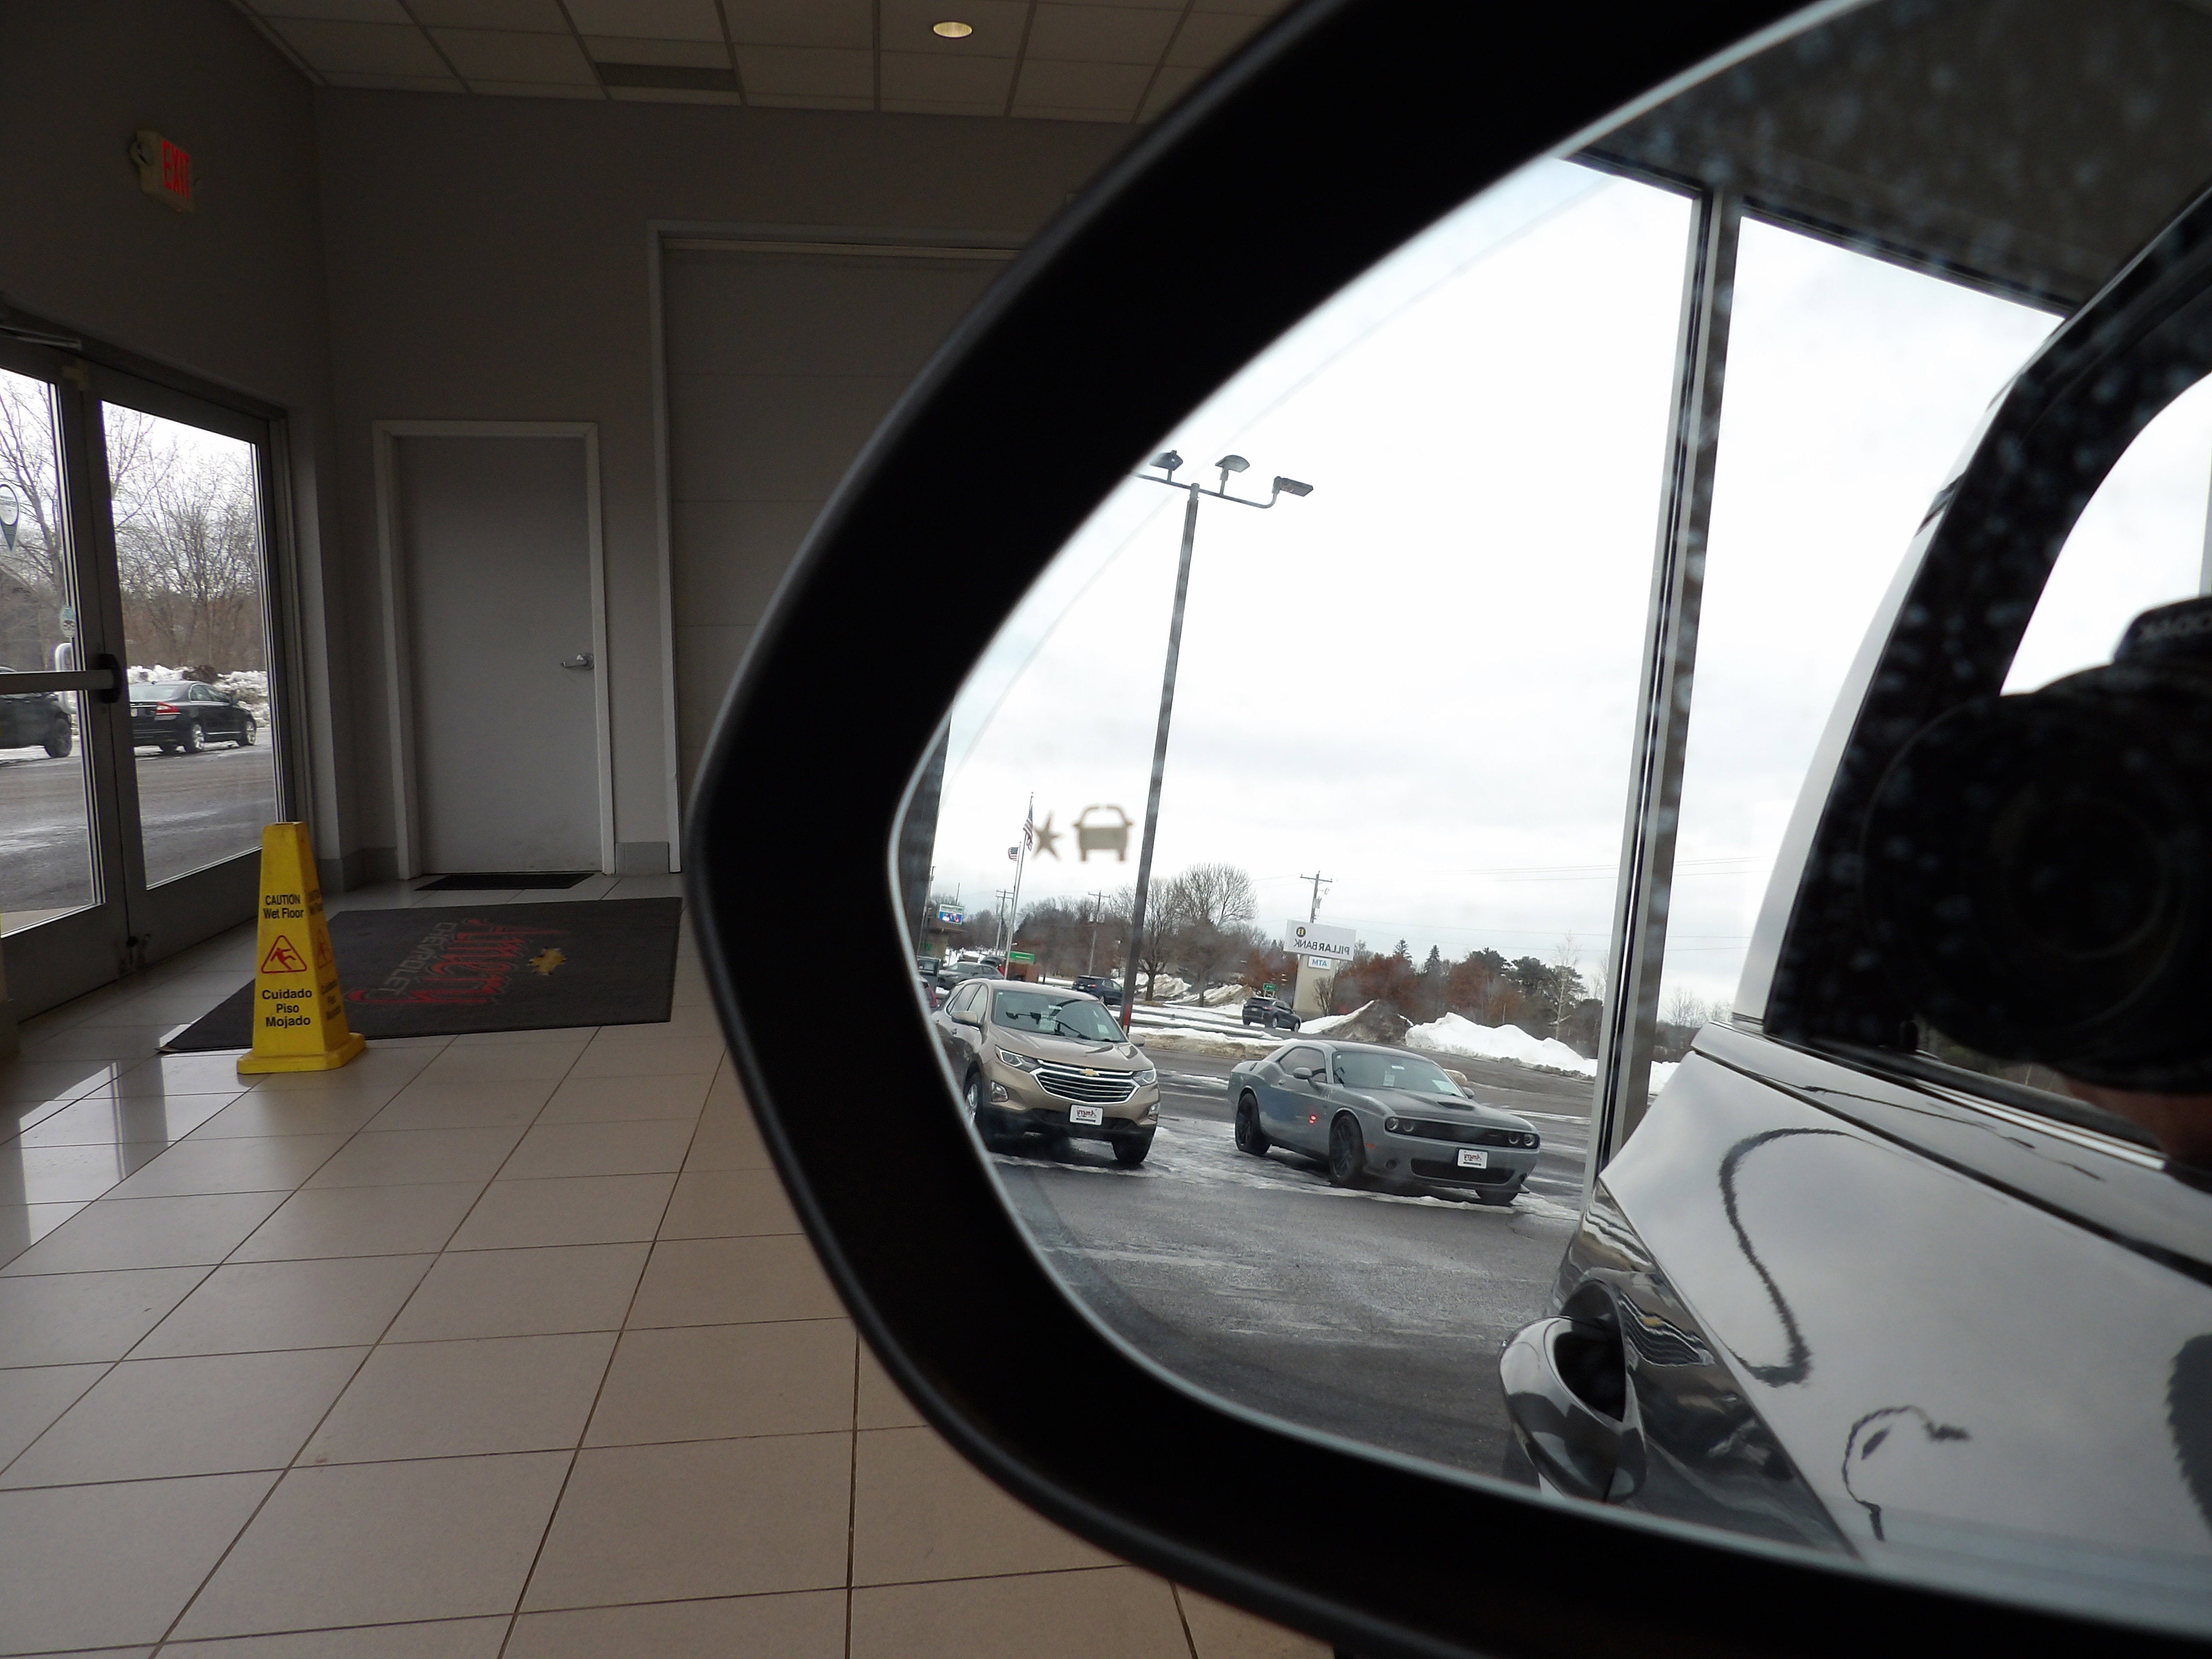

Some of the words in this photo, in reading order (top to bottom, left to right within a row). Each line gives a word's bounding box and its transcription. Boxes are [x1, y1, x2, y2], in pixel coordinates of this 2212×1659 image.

[162, 140, 189, 200] EXIT
[265, 893, 301, 905] CAUTION
[263, 908, 280, 919] Wet
[282, 907, 304, 919] Floor
[378, 922, 457, 996] CHEVROLET
[262, 988, 313, 1000] Cuidado
[276, 1003, 300, 1014] Piso
[265, 1015, 311, 1029] Mojado
